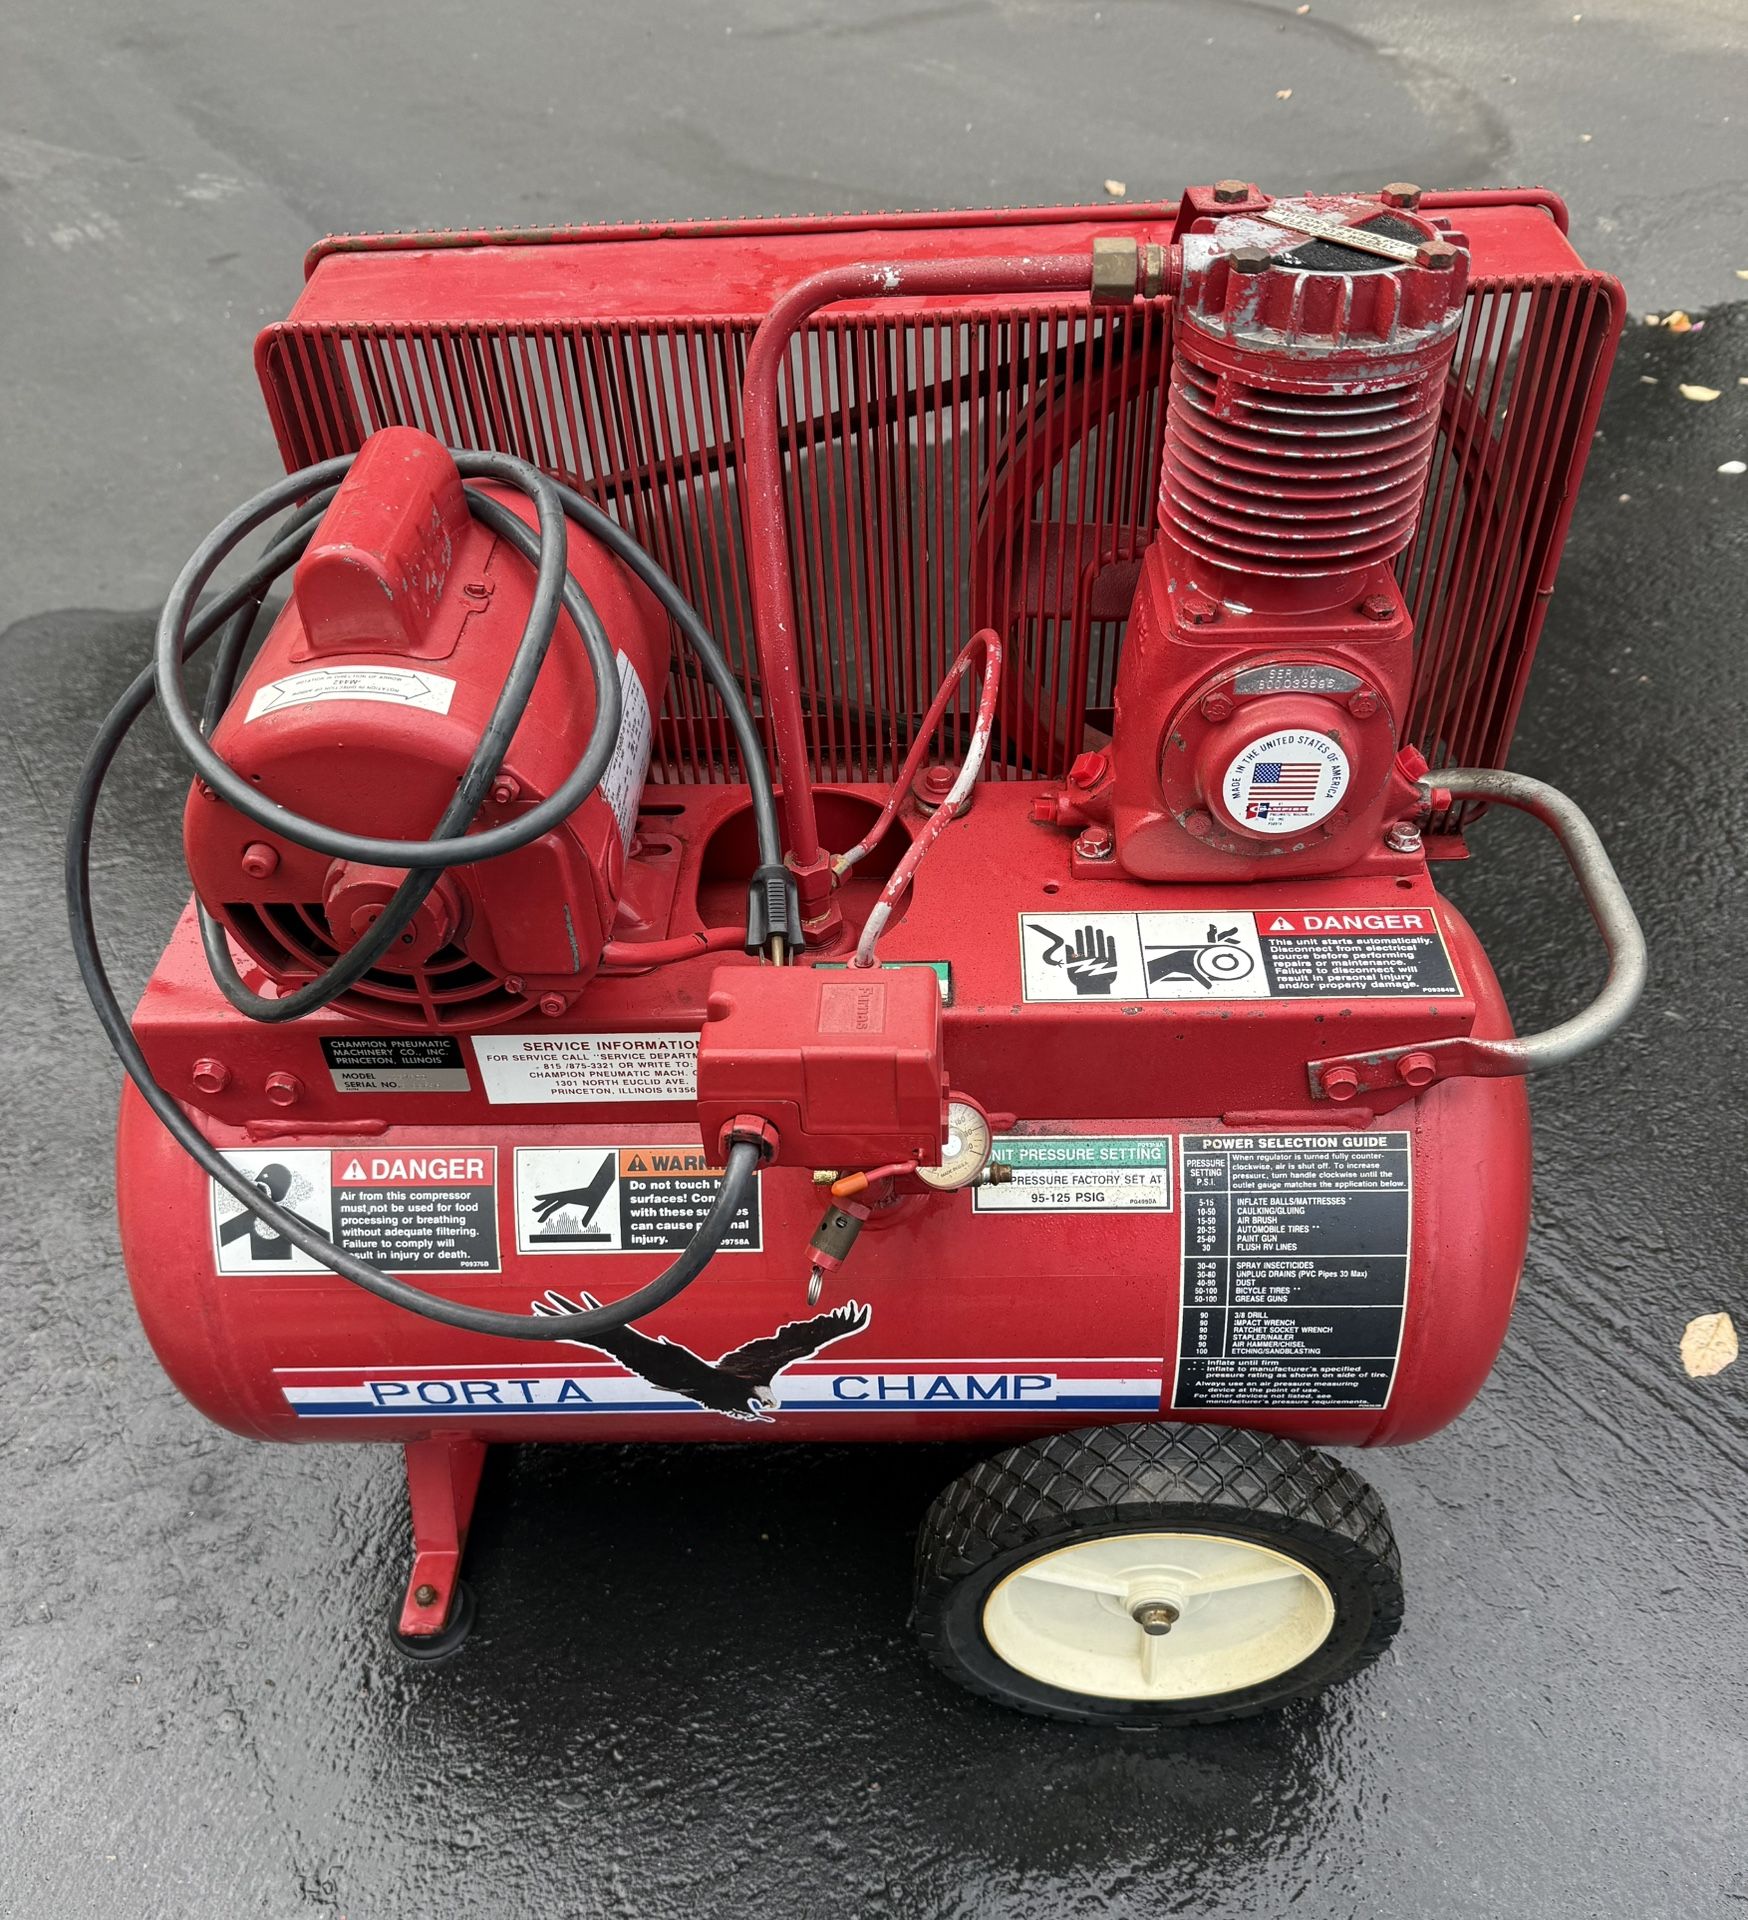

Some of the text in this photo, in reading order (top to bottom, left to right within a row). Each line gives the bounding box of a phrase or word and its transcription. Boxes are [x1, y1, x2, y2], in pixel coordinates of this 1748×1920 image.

[1232, 736, 1341, 799] MADE IN THE UNITED STATES OF AMERICA
[1304, 915, 1423, 930] DANGER
[1357, 936, 1433, 945] automatically.
[1353, 952, 1414, 960] performing
[1328, 974, 1376, 982] personal
[1319, 982, 1366, 990] property
[523, 1042, 590, 1051] SERVICE
[1203, 1137, 1387, 1149] POWER SELECTION GUIDE
[987, 1148, 1161, 1161] NIT PRESSURE SETTING
[371, 1159, 484, 1179] DANGER
[630, 1181, 646, 1190] Do
[675, 1180, 710, 1189] touch
[1010, 1175, 1162, 1185] PRESSURE FACTORY SET AT
[340, 1192, 471, 1201] Air from this compressor
[630, 1194, 687, 1204] surfaces!
[1032, 1193, 1104, 1203] 95-125 PSIG
[1270, 1197, 1345, 1205] BALLS/MATTRESSES
[341, 1203, 478, 1213] must not be used for food
[631, 1208, 656, 1216] with
[660, 1208, 694, 1216] these
[1237, 1207, 1305, 1215] CAULKING/GLUING
[342, 1214, 465, 1226] processing or breathing
[631, 1222, 653, 1230] can
[656, 1222, 693, 1230] cause
[342, 1228, 479, 1238] without adequate filtering.
[343, 1240, 377, 1248] Failure
[395, 1239, 433, 1249] comply
[437, 1239, 454, 1247] will
[632, 1235, 668, 1245] injury.
[350, 1250, 470, 1261] sult in injury or death.
[1236, 1295, 1264, 1303] GREASE
[370, 1375, 1052, 1405] PORTA CHAMP
